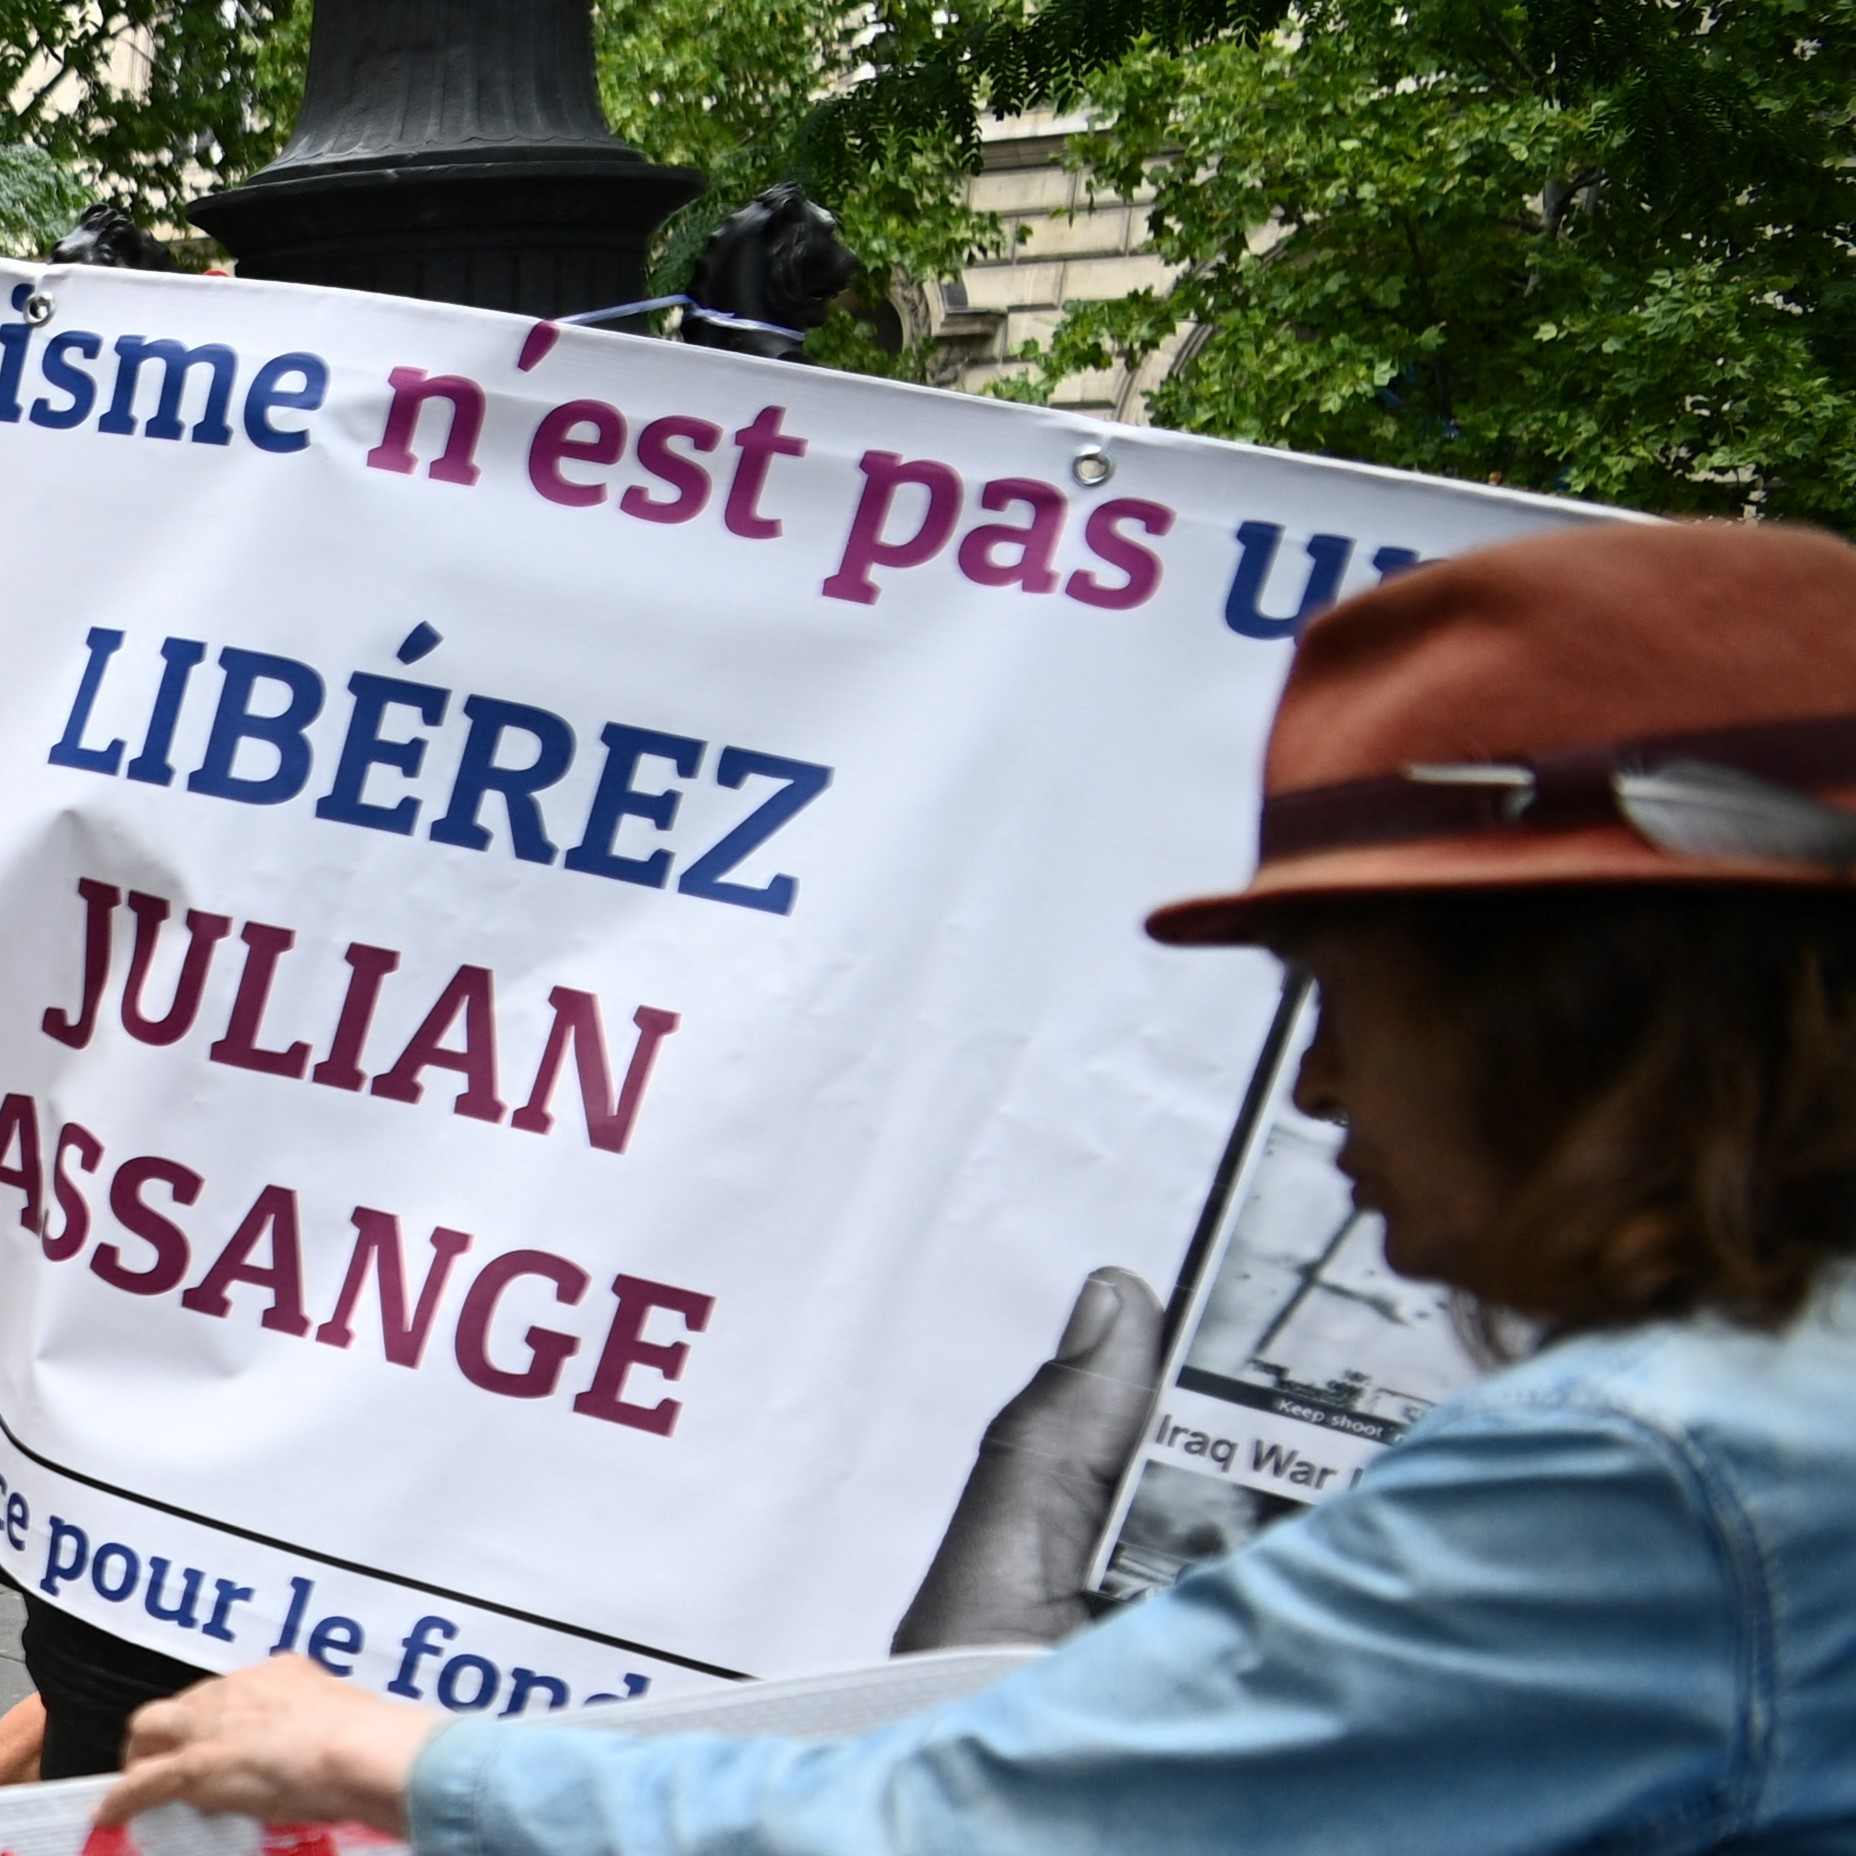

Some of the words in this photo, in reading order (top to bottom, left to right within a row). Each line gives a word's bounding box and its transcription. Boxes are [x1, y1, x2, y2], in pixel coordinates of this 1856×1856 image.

[367, 319, 806, 540] n'est
[821, 450, 1175, 607] pas
[48, 621, 833, 914] LIBÉREZ
[41, 877, 681, 1154] JULIAN
[1154, 1412, 1239, 1473] Iraq
[1251, 1438, 1337, 1490] War
[1277, 1398, 1325, 1425] Keep
[40, 1516, 251, 1642] pour
[270, 1577, 364, 1677] le
